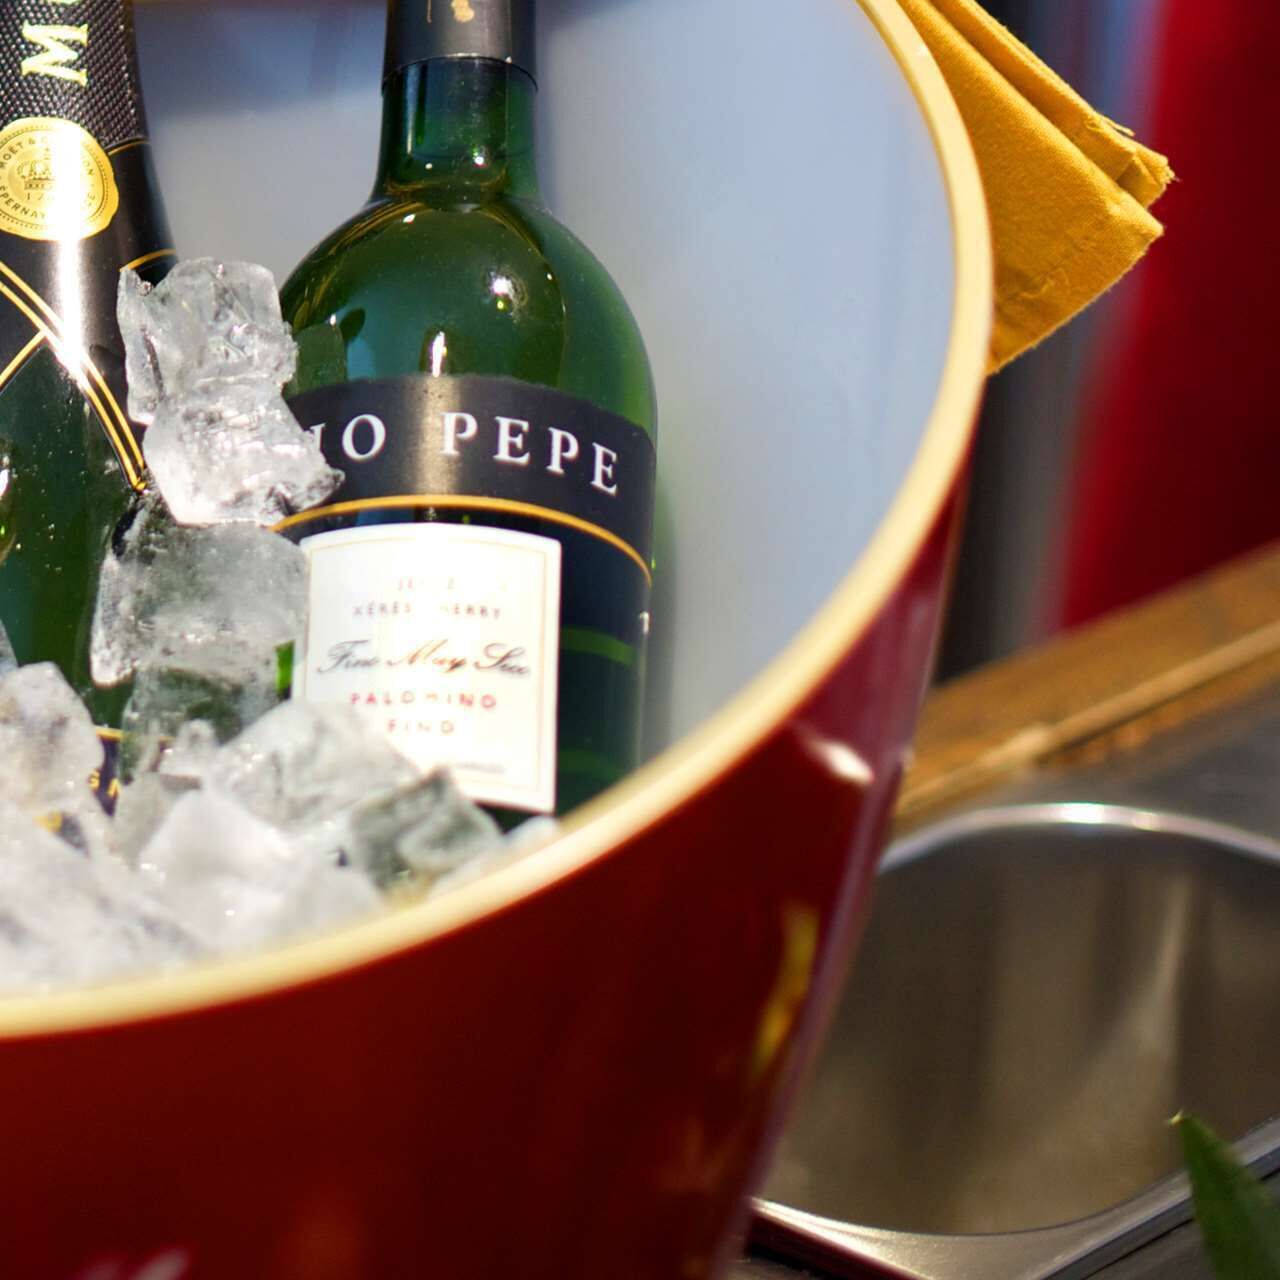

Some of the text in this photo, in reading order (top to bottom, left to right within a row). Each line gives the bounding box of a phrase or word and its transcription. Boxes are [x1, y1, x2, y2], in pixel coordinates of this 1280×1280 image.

[309, 411, 620, 496] IO PEPE
[351, 690, 497, 710] PALOMINO
